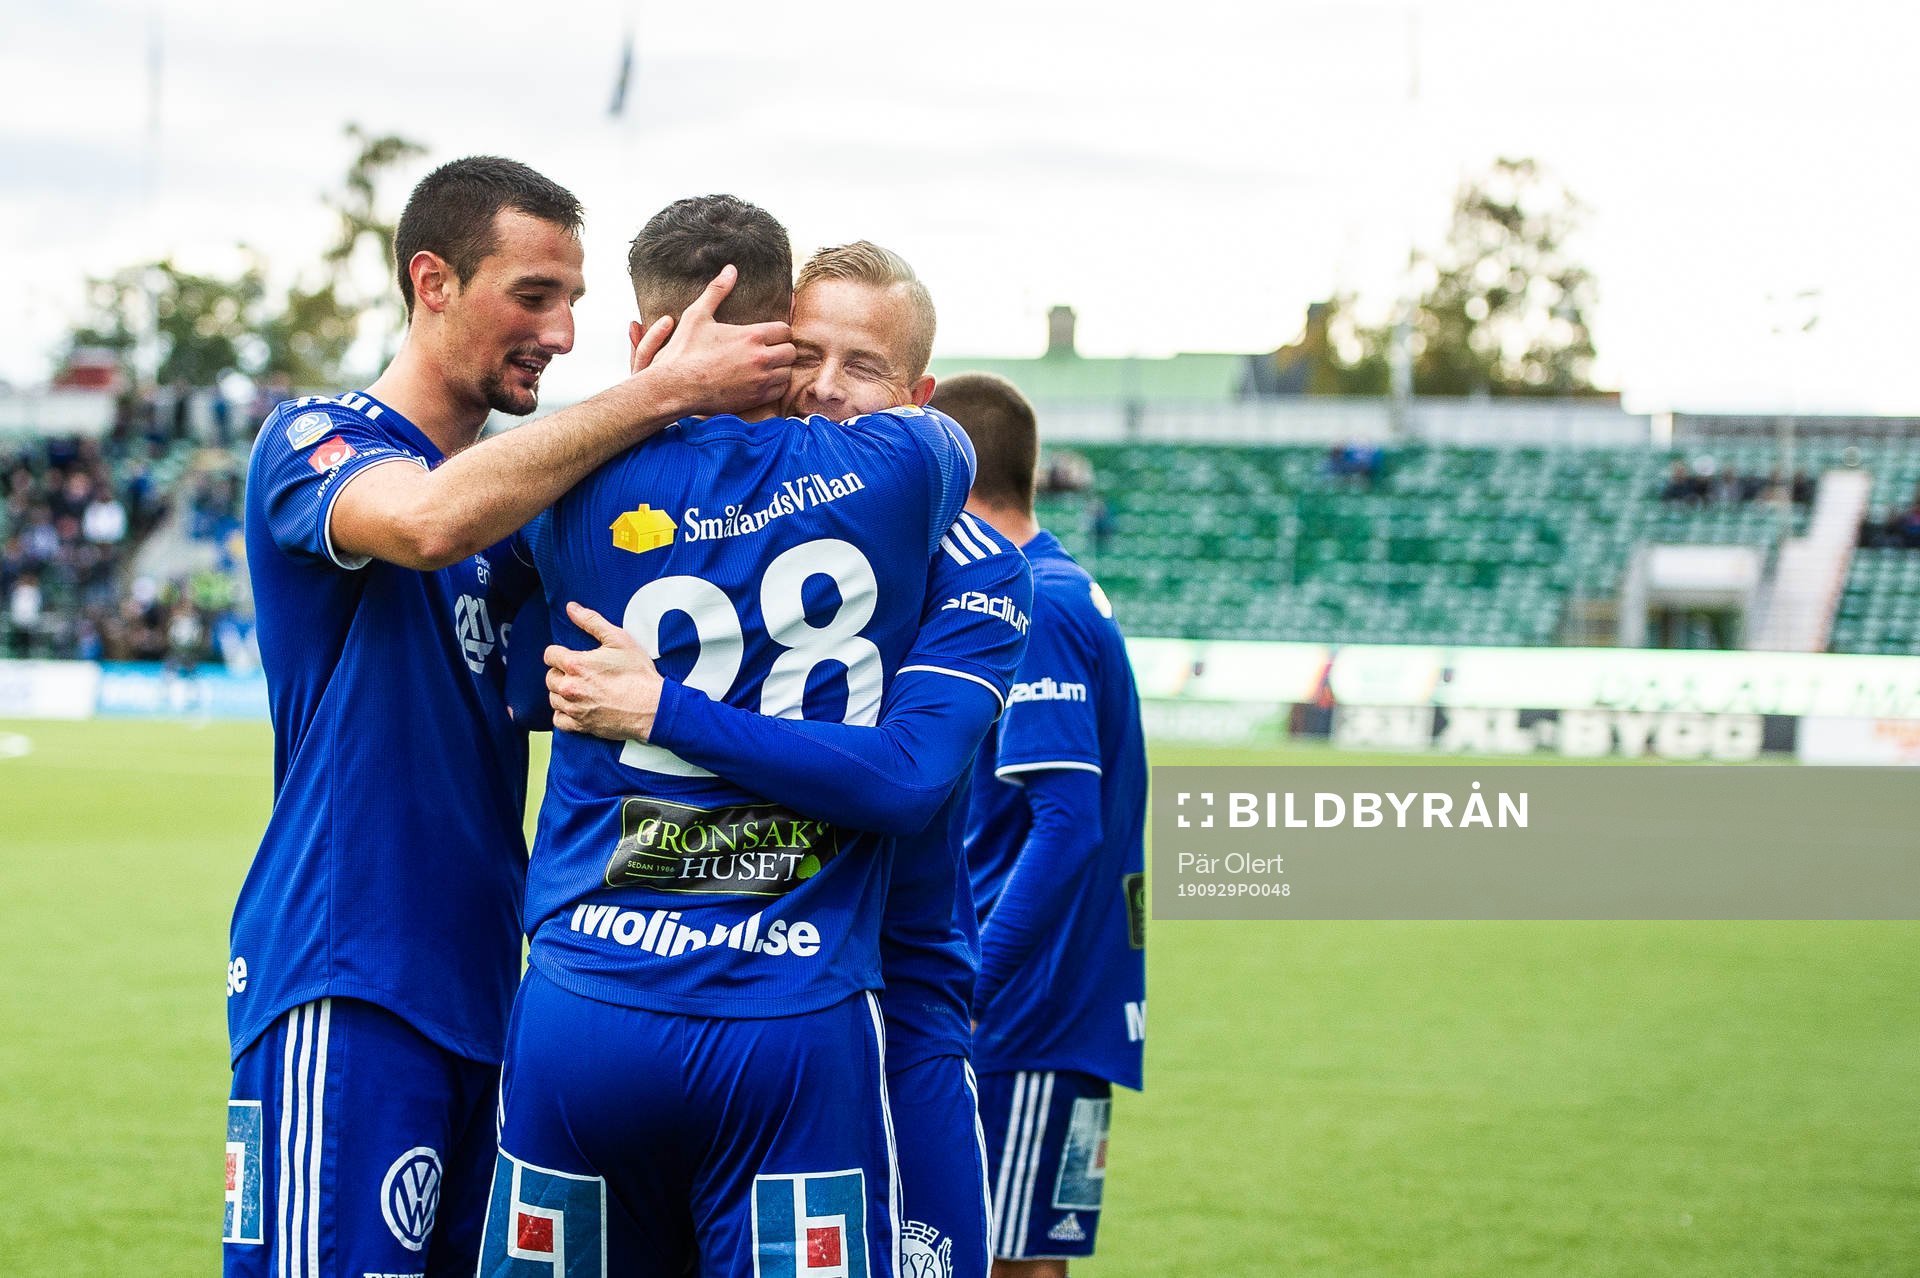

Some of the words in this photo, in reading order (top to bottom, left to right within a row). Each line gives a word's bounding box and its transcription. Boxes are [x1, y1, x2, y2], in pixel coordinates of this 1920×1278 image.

[684, 472, 865, 543] SmålandsVillan
[618, 538, 883, 777] 28
[1005, 677, 1087, 708] adium
[627, 860, 654, 871] SEDAN
[678, 852, 805, 882] HUSET
